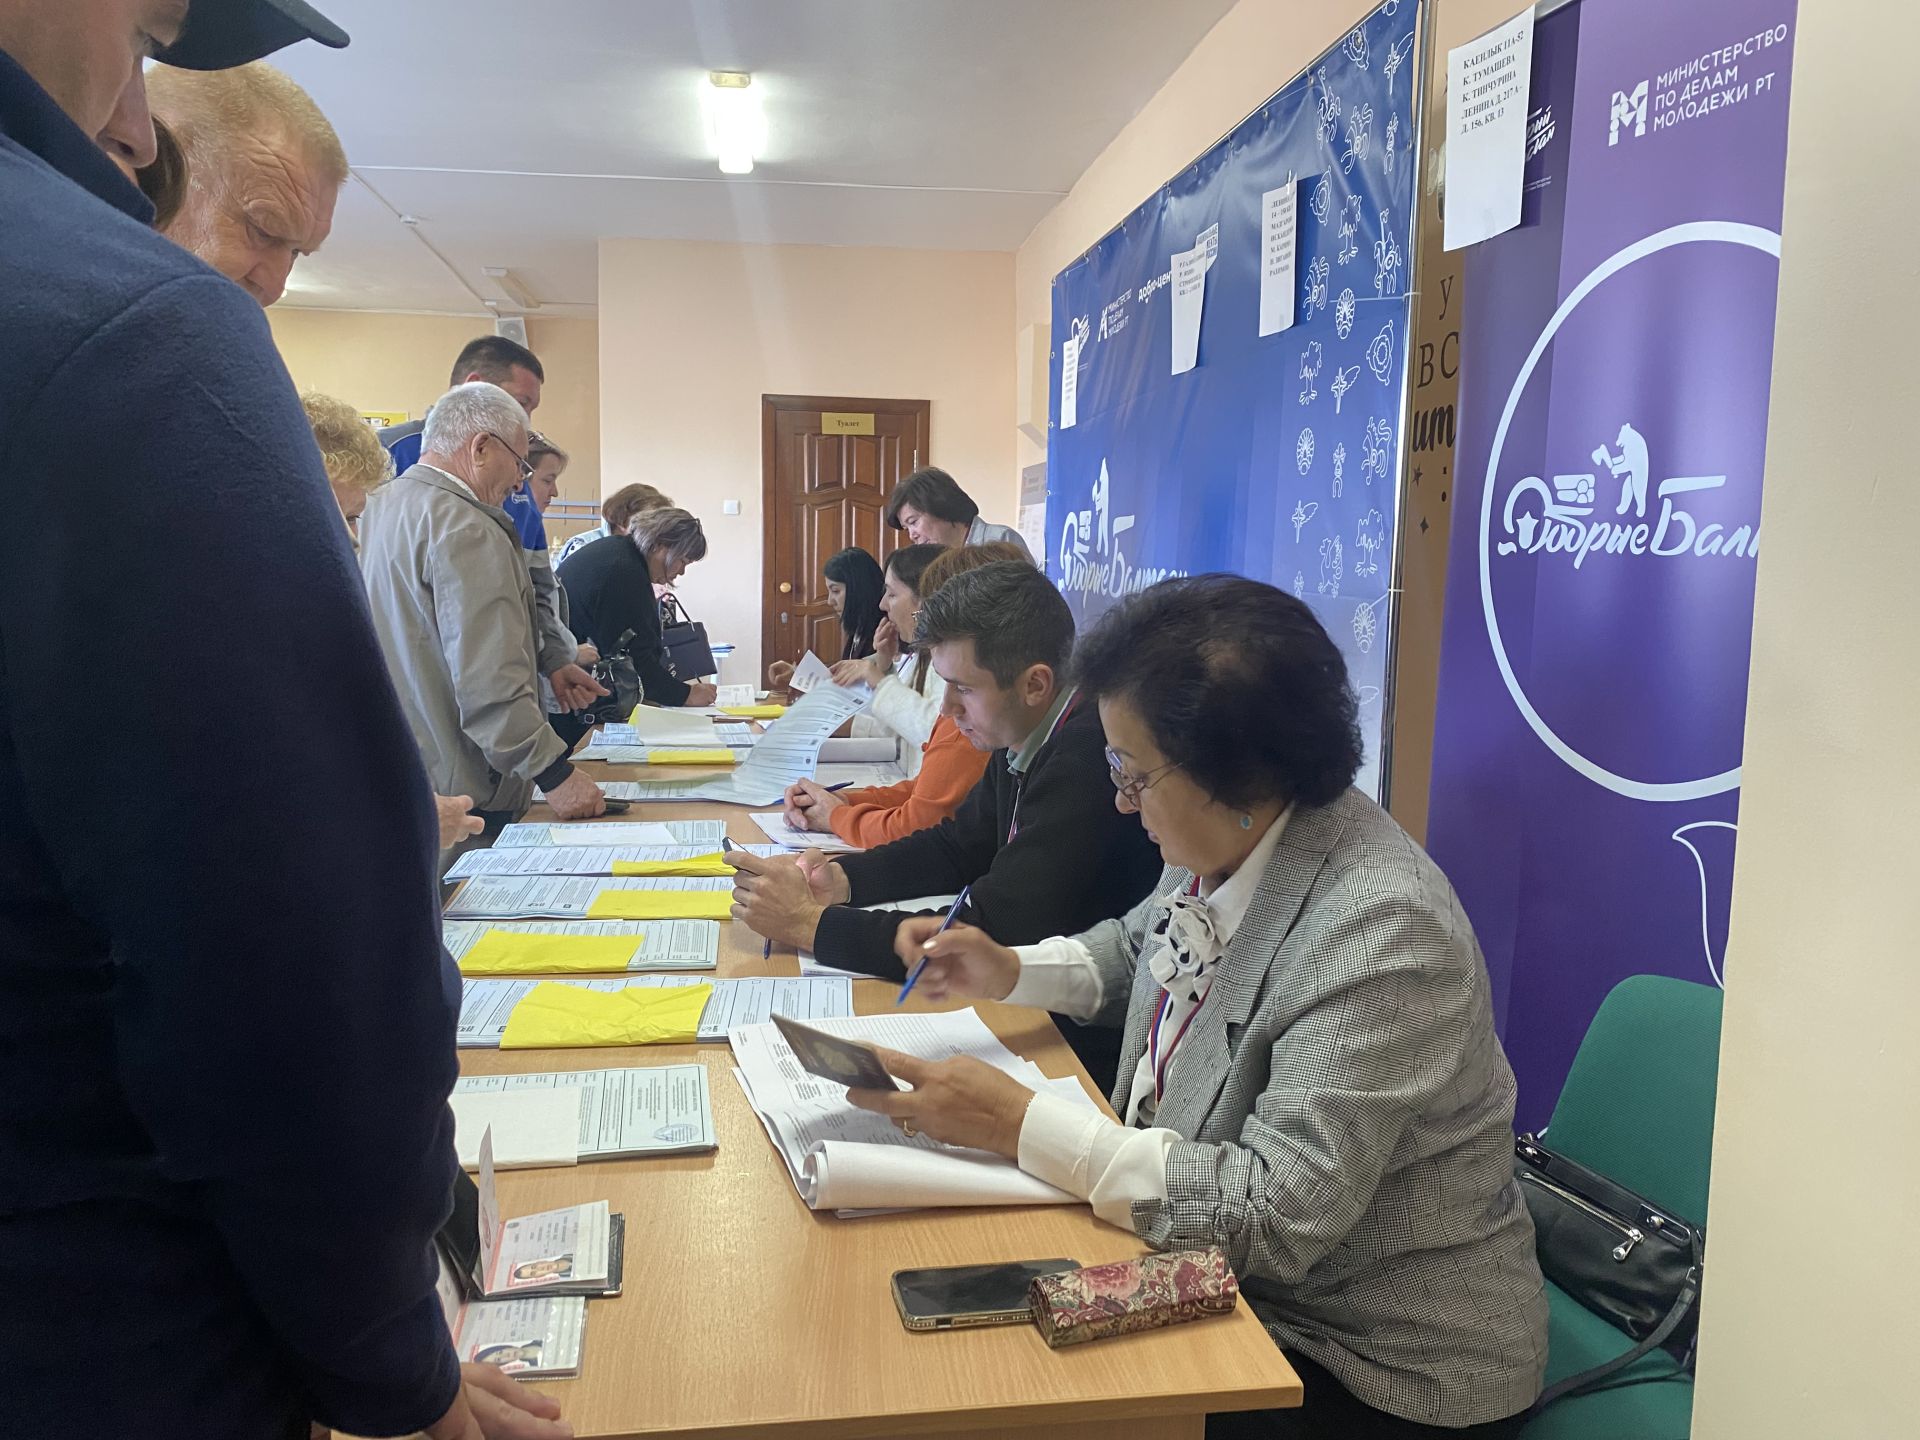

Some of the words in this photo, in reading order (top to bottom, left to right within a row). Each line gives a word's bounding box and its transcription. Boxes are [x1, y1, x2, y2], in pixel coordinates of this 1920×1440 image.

[1473, 54, 1515, 82] ТУМАШЕВА
[1656, 24, 1787, 90] МИНИСТЕРСТВО
[1472, 70, 1516, 99] ТИНЧУРИНА
[1655, 90, 1676, 111] ПО
[1680, 65, 1738, 104] ДЕЛАМ
[1461, 99, 1495, 120] ЛЕНИНА
[1654, 83, 1748, 131] МОЛОДЕЖИ
[1755, 72, 1775, 95] РТ
[836, 419, 860, 428] Туалет
